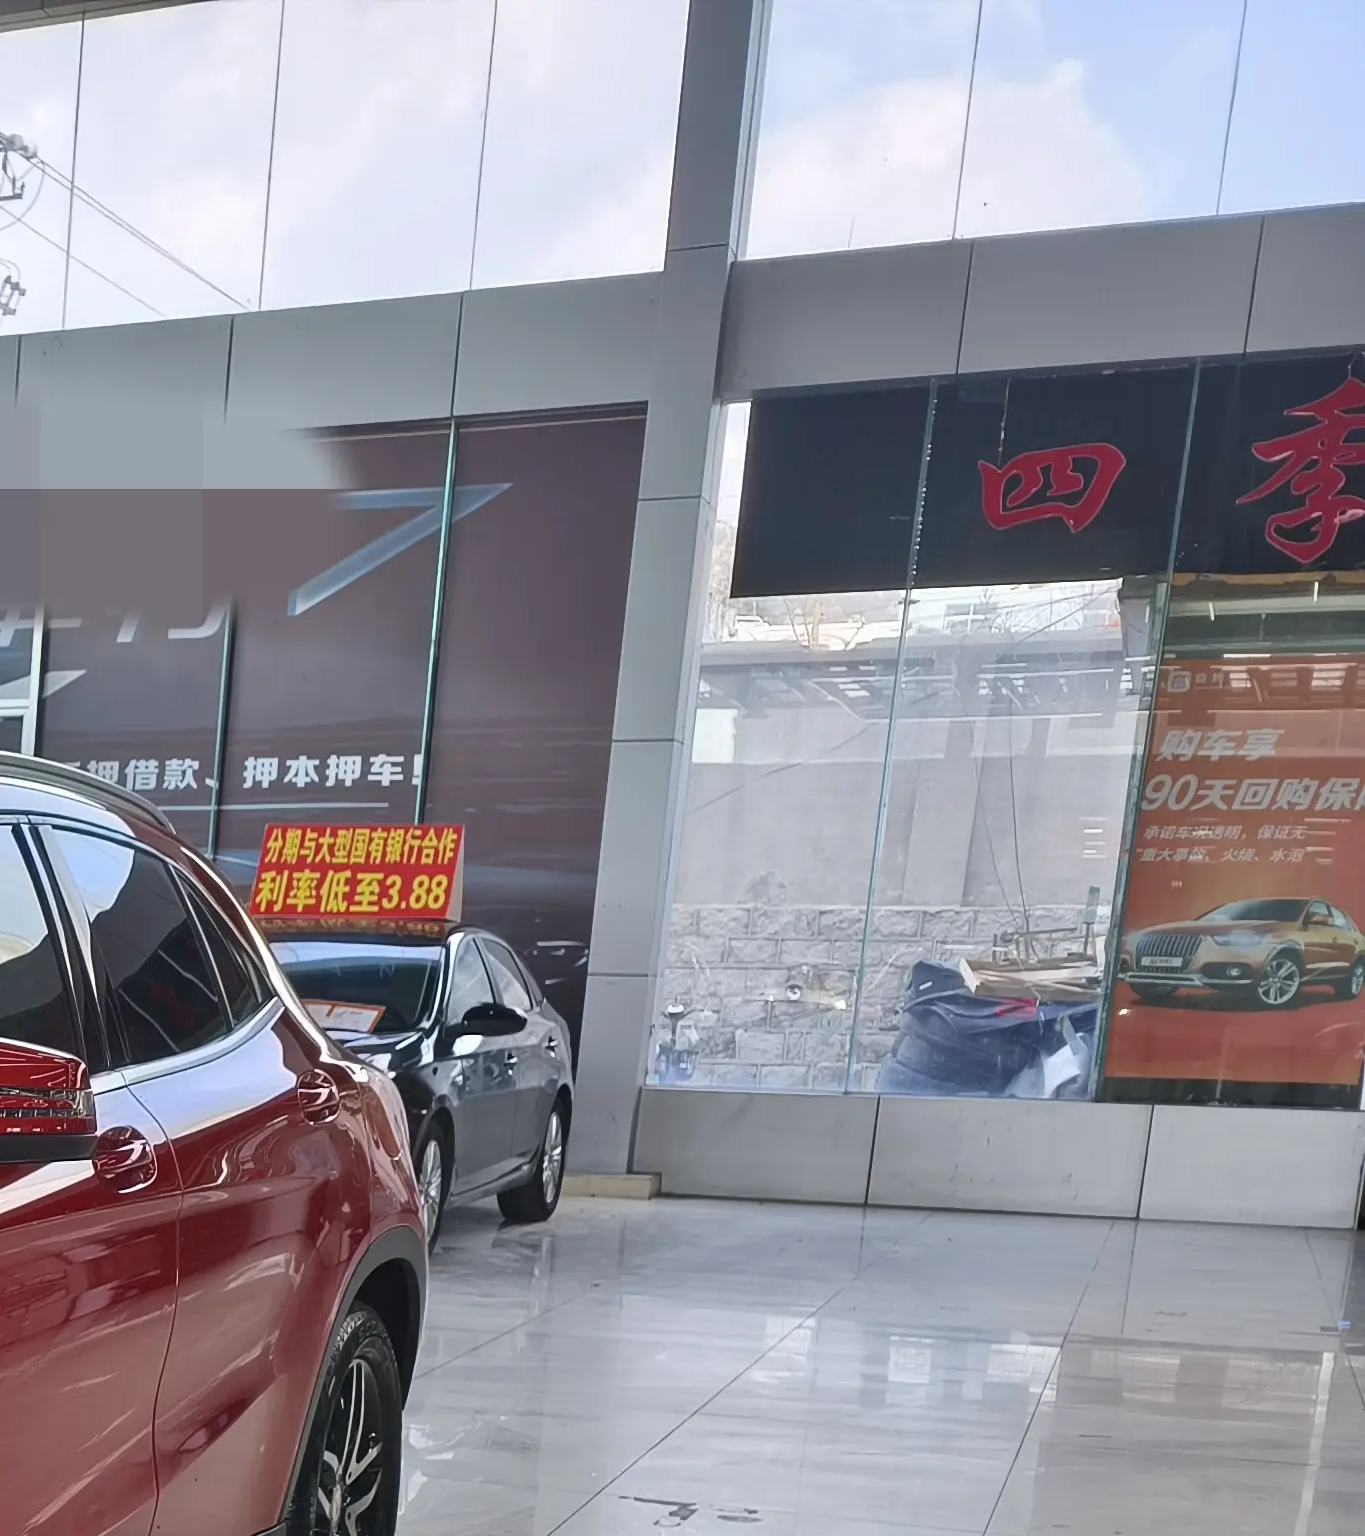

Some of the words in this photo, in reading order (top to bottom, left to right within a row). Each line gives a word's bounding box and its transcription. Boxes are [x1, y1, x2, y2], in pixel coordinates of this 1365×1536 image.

[978, 377, 1365, 563] 四季
[1156, 728, 1284, 762] 购车享
[265, 827, 457, 864] 分期与大型国有银行合作
[255, 869, 448, 913] 利率低至3.88
